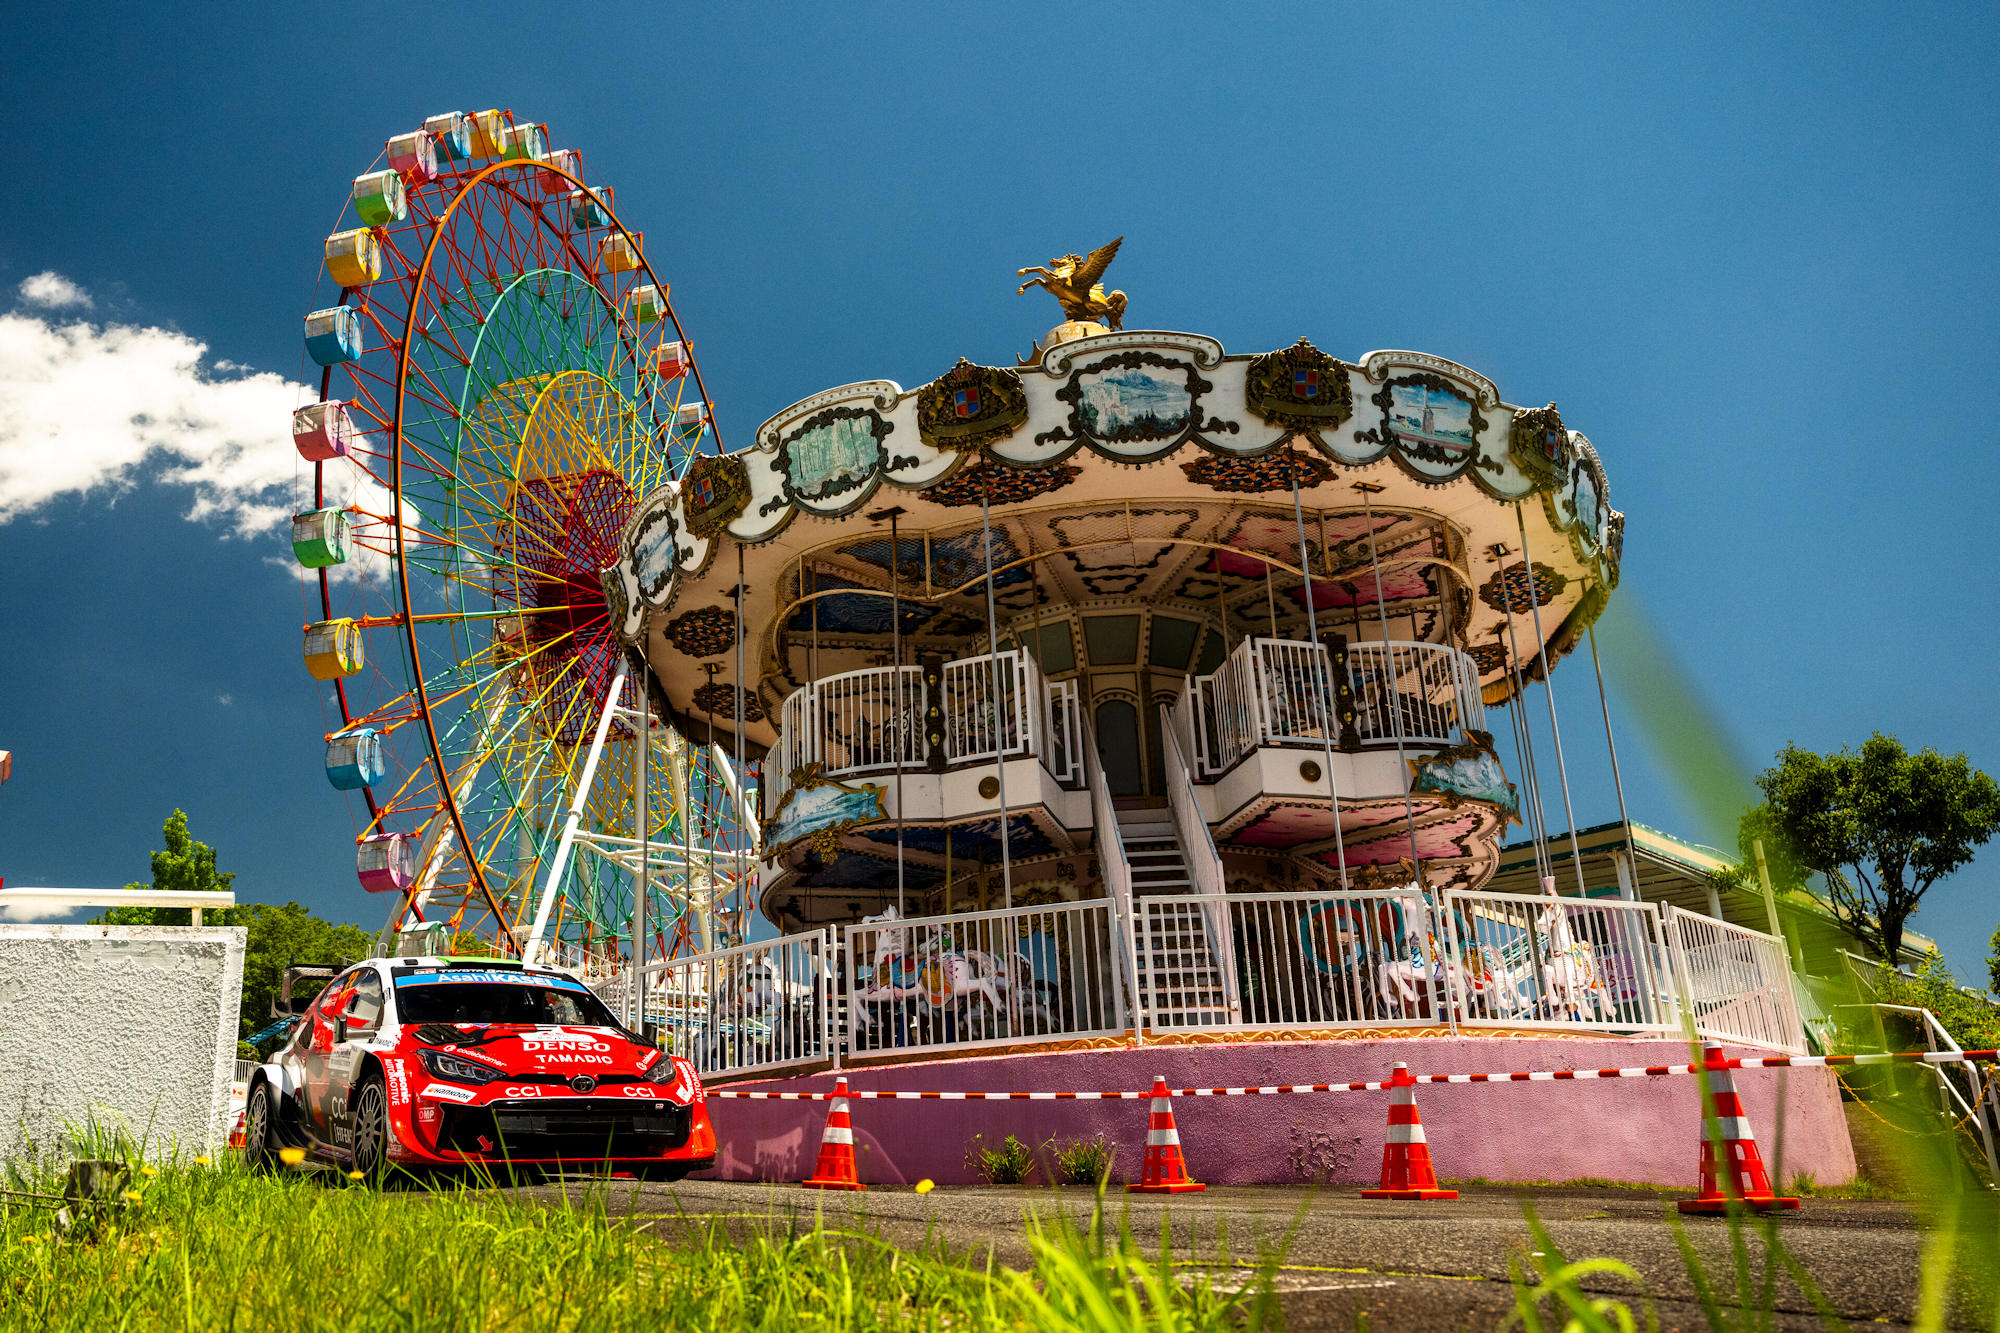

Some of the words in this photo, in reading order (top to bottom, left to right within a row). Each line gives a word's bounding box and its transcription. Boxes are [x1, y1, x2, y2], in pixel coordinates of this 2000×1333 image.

[522, 1041, 611, 1052] DENSO
[535, 1053, 613, 1064] TAMADIC
[384, 1058, 400, 1106] AUTOMOTIVE
[505, 1085, 542, 1097] CCI
[623, 1086, 656, 1097] CCI
[418, 1109, 435, 1119] OMP
